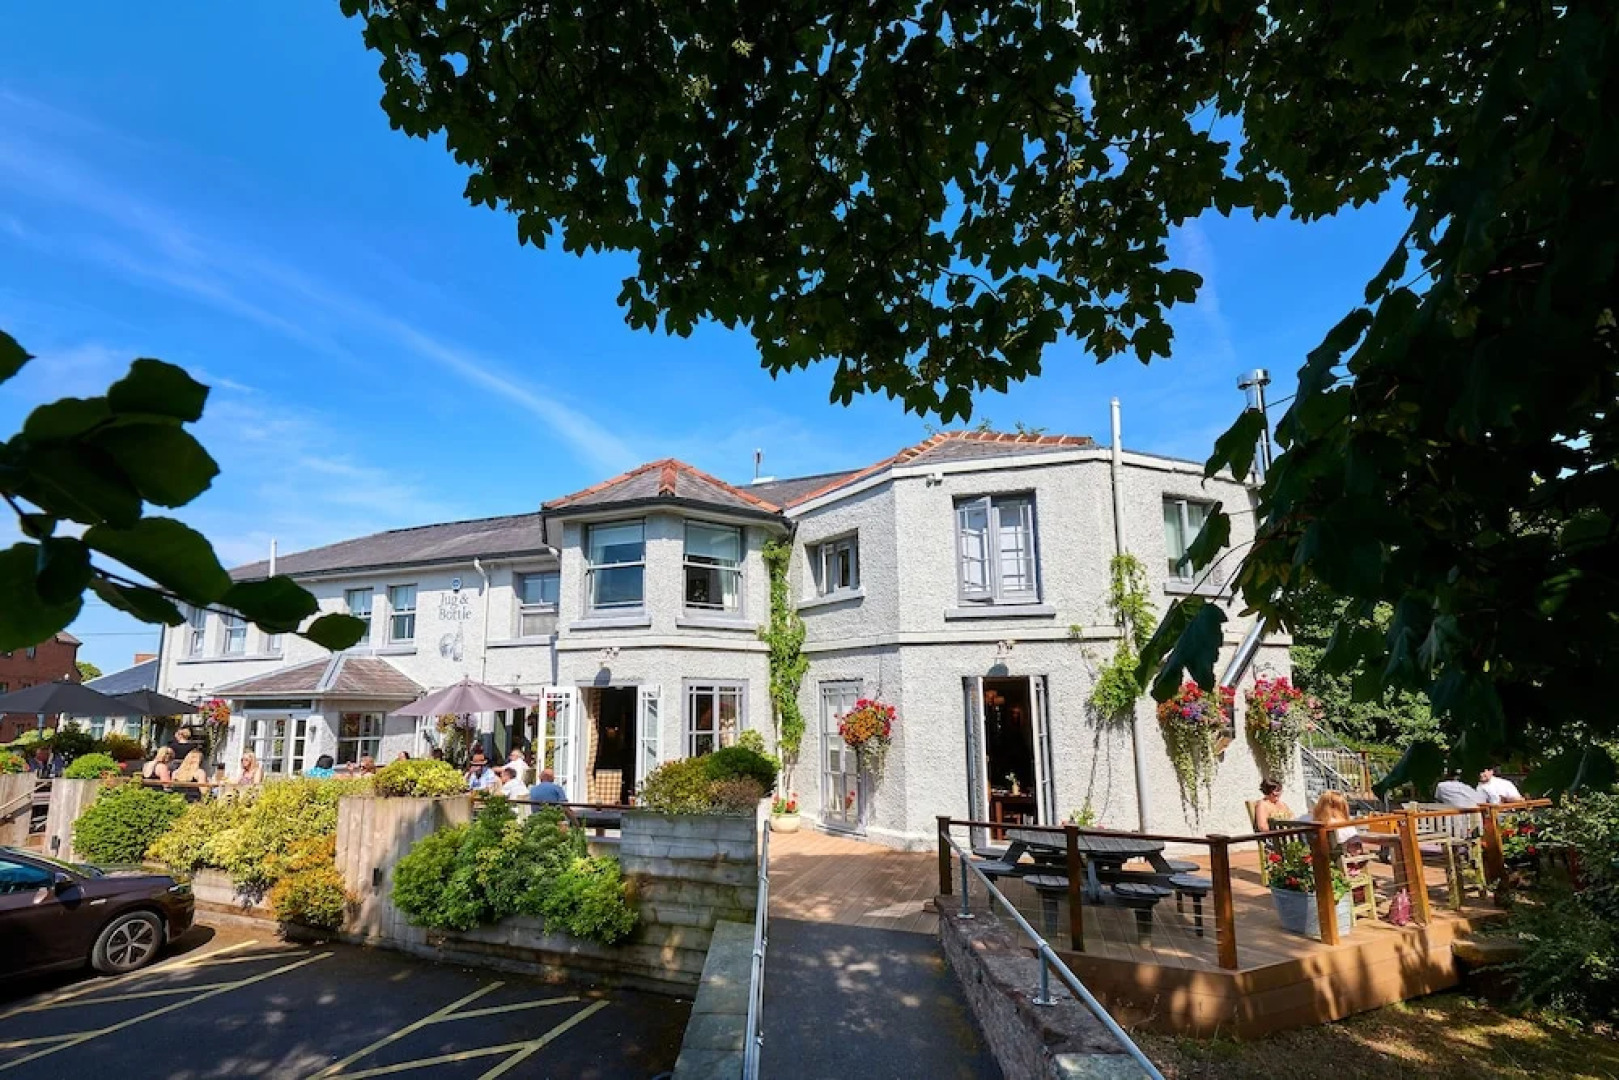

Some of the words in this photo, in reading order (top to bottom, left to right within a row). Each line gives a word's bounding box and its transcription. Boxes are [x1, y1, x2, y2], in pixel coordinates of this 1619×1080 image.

[438, 592, 458, 609] Jug
[459, 593, 469, 605] &
[439, 606, 472, 620] Bottle
